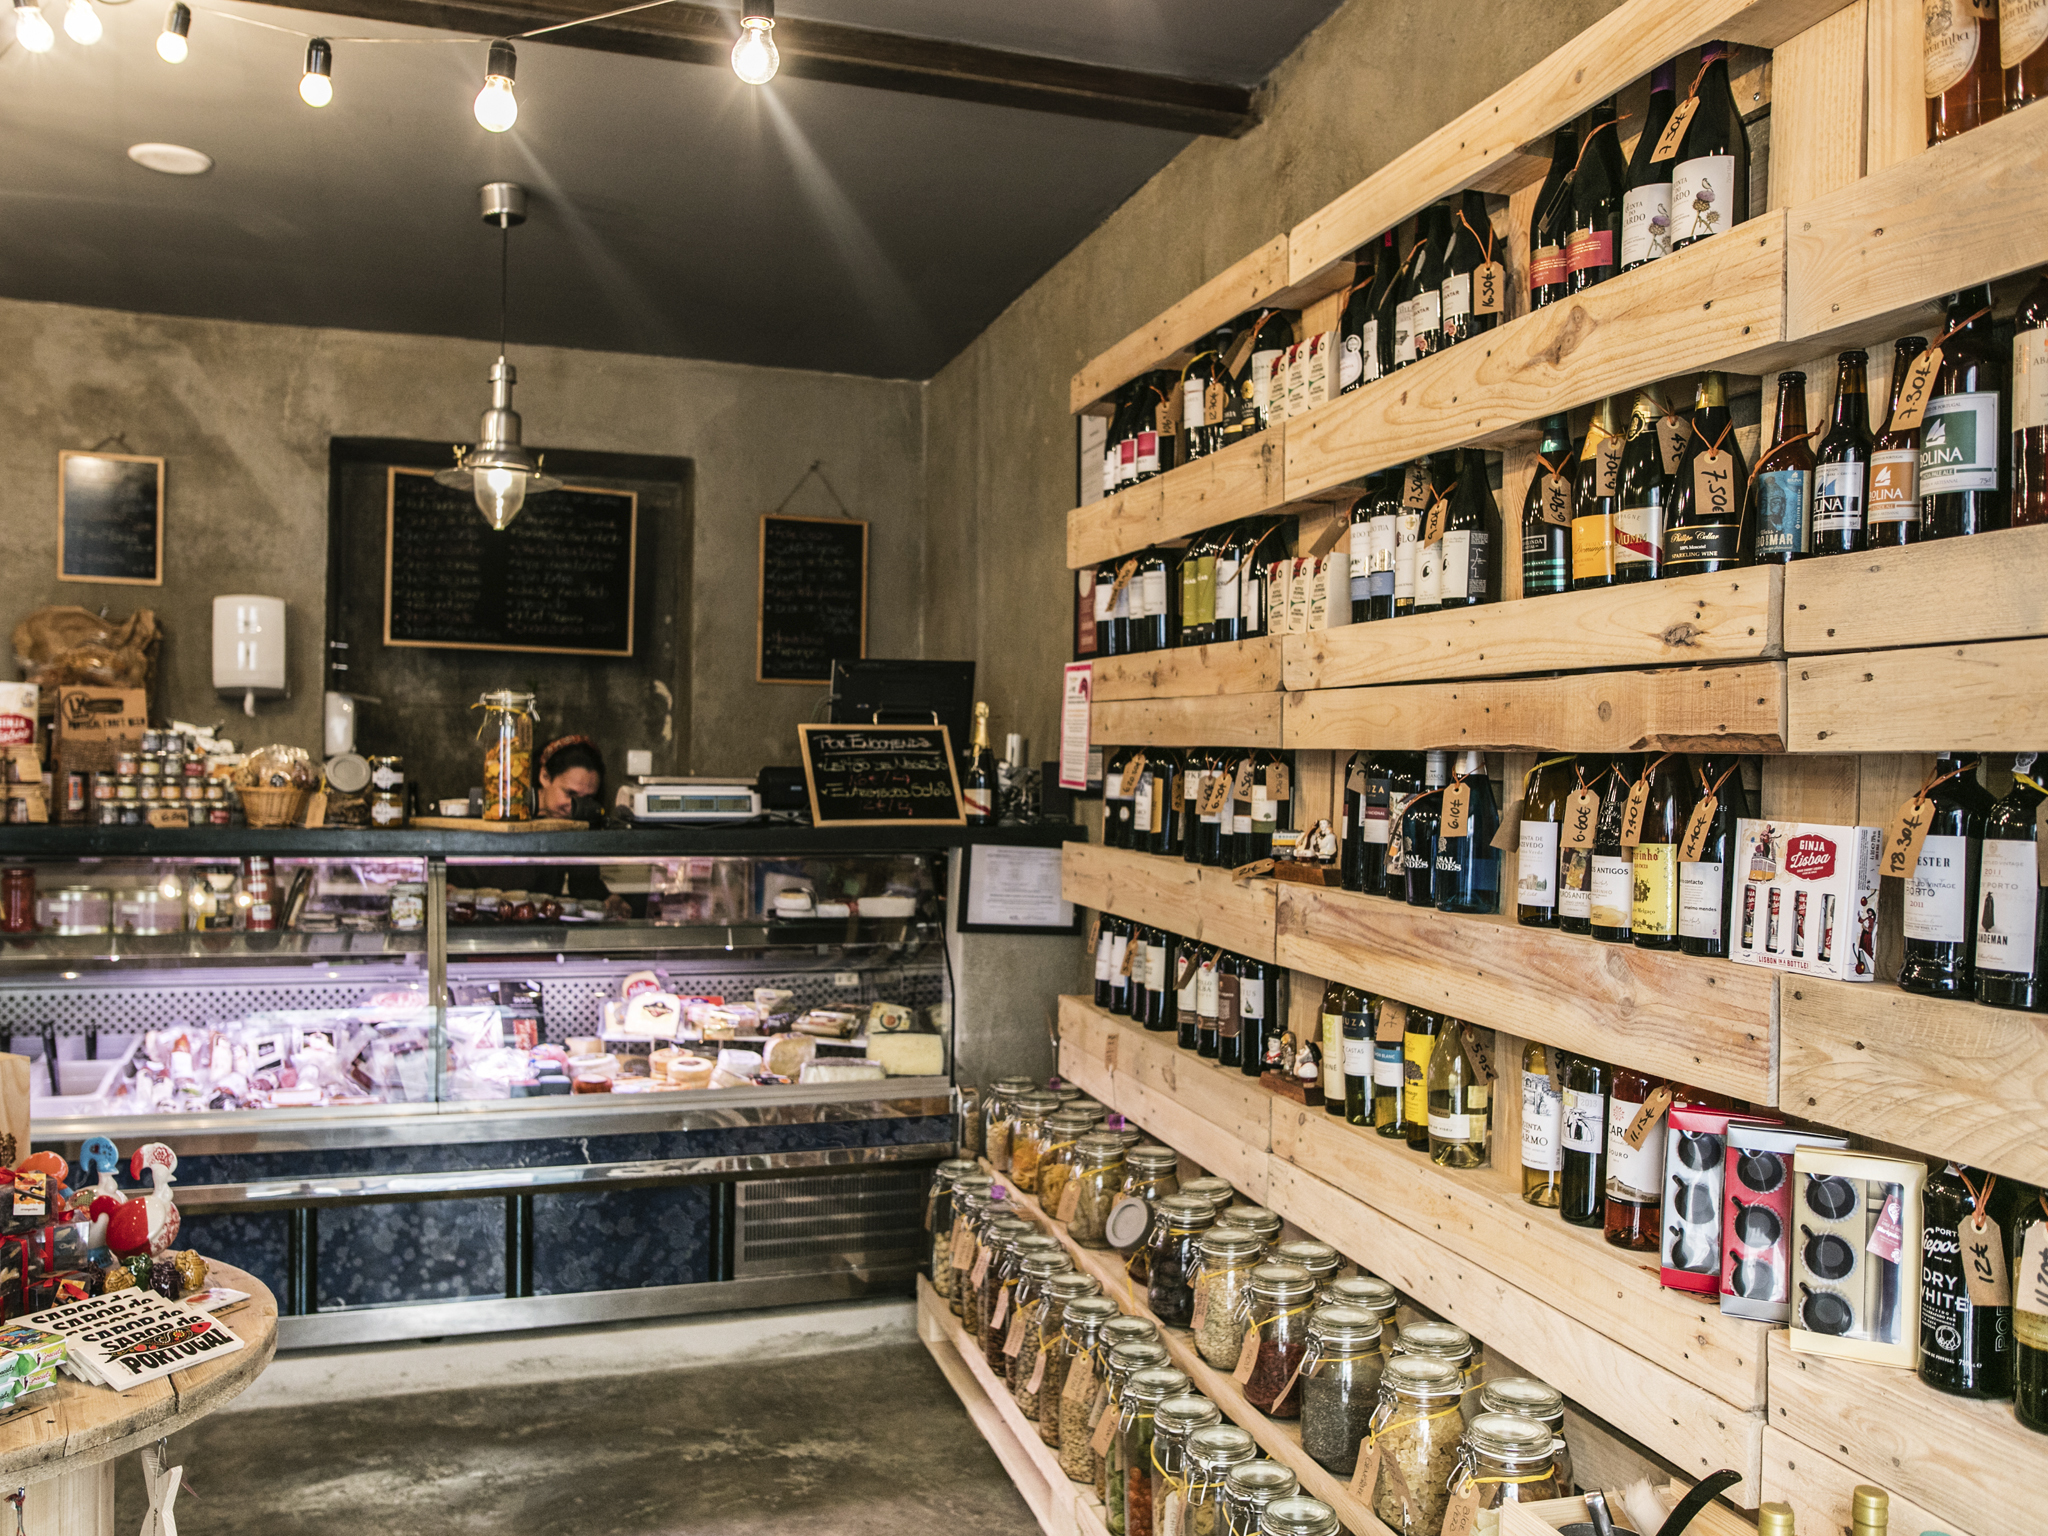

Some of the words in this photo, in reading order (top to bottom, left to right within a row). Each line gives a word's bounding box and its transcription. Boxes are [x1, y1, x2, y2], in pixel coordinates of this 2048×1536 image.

[1673, 190, 1691, 203] ARDO
[1899, 361, 1932, 420] 7.30€
[1701, 469, 1728, 513] 7.50€
[1549, 487, 1568, 523] 6.90€
[1672, 551, 1701, 559] SPARKLING
[1447, 799, 1463, 830] 6.10€
[1572, 806, 1592, 843] 6.60€
[1686, 813, 1708, 859] 14.40€
[1799, 840, 1825, 852] GINJA
[1790, 851, 1831, 868] Lisboa
[1917, 856, 1951, 868] ESTER
[1597, 867, 1629, 875] ANTIGOS
[1984, 868, 2002, 876] 2011
[1906, 887, 1936, 897] PORTO
[1927, 881, 1957, 889] VINTAGE
[1986, 881, 2019, 891] PORTO
[1909, 900, 1924, 909] 2011
[1758, 955, 1777, 965] LISBON
[1787, 959, 1809, 970] BOTTLE!
[1471, 1042, 1494, 1082] 5.95€
[1630, 1106, 1655, 1142] 11.15€
[1935, 1226, 1960, 1238] PORT
[1970, 1243, 1995, 1284] 12€
[1922, 1266, 1958, 1291] DRY
[119, 1327, 235, 1375] PORTUGAL
